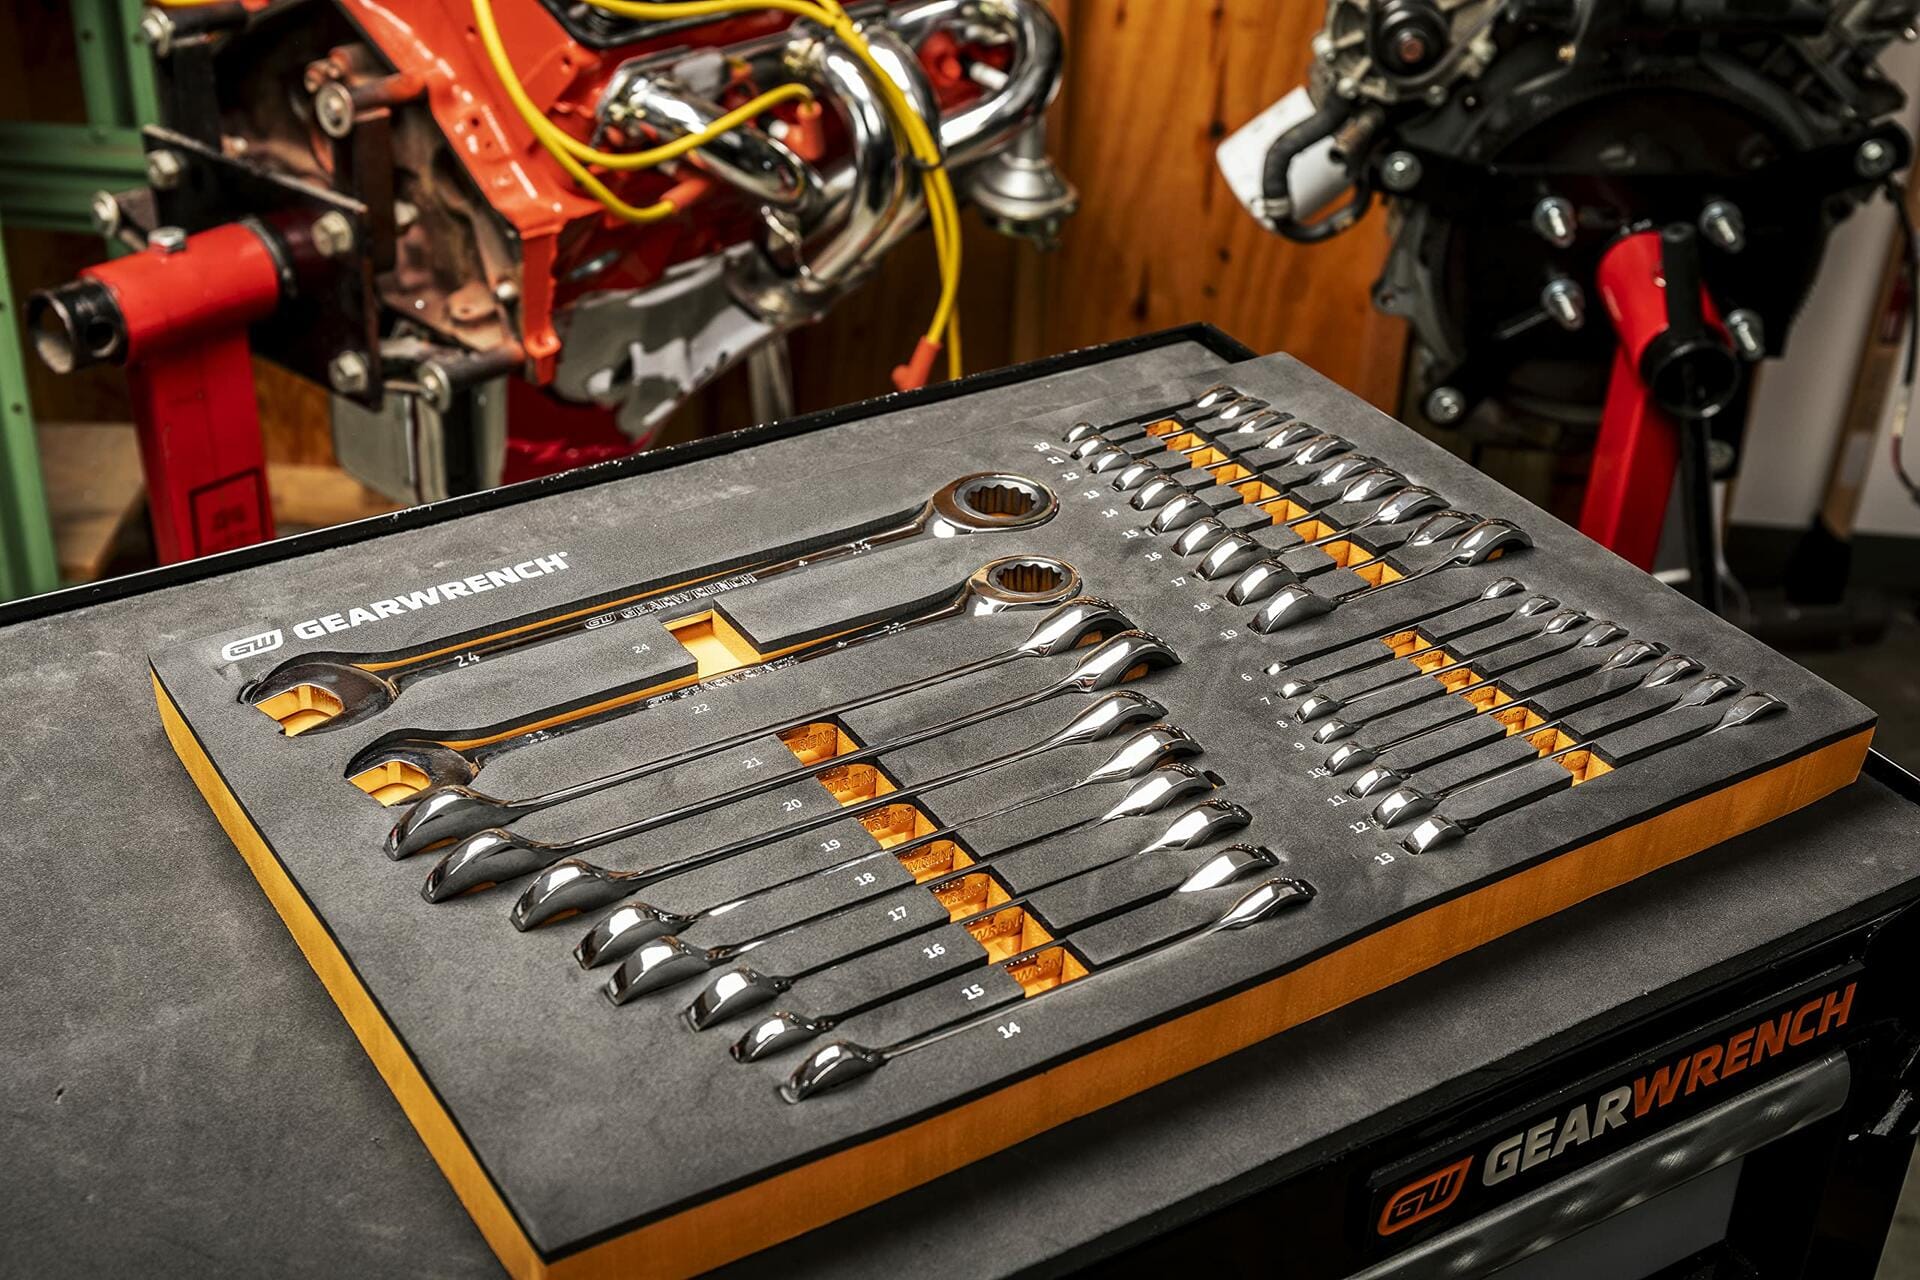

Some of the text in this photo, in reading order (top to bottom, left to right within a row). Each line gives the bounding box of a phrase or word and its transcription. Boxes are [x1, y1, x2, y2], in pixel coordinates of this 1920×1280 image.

[1033, 441, 1051, 452] 10
[1046, 456, 1065, 465] 11
[1062, 471, 1080, 481] 12
[1083, 490, 1100, 500] 13
[1101, 508, 1119, 519] 14
[1121, 529, 1140, 539] 15
[1144, 551, 1163, 562] 16
[1170, 576, 1187, 587] 17
[1193, 602, 1212, 613] 18
[1220, 629, 1239, 641] 19
[632, 643, 651, 654] 24
[454, 651, 480, 668] 24
[1241, 673, 1253, 682] 6
[1260, 695, 1272, 705] 7
[691, 703, 710, 715] 22
[1276, 719, 1289, 729] 8
[1294, 742, 1306, 752] 9
[742, 756, 764, 769] 21
[782, 799, 803, 812] 20
[1326, 794, 1348, 807] 11
[1349, 820, 1371, 834] 12
[820, 839, 841, 852] 19
[1374, 852, 1395, 866] 13
[854, 872, 876, 886] 18
[887, 906, 907, 922] 17
[923, 943, 946, 959] 16
[961, 984, 985, 1001] 15
[997, 1021, 1021, 1039] 14
[1482, 982, 1858, 1187] GEARWRENCH
